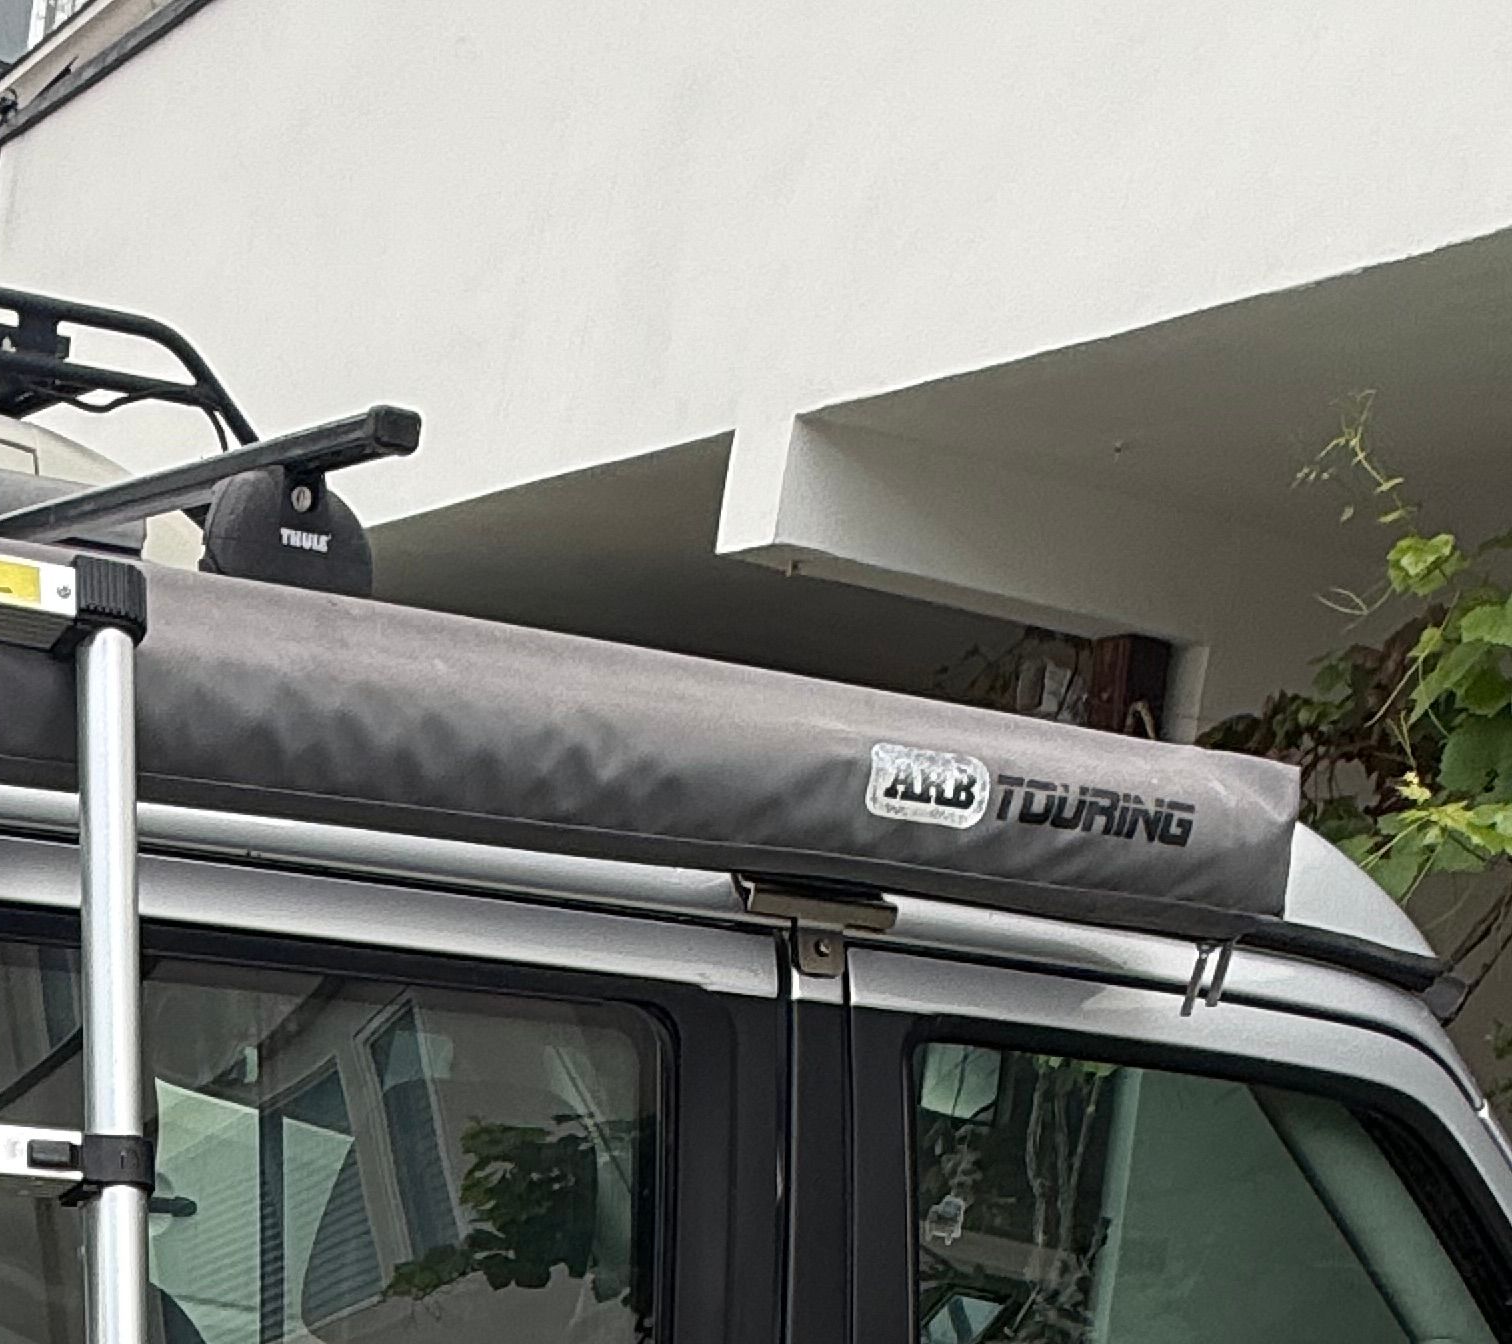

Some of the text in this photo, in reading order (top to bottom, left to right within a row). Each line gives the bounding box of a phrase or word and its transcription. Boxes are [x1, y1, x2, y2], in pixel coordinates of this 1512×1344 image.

[280, 527, 329, 553] THULE
[884, 764, 1196, 848] ARB TOURING
